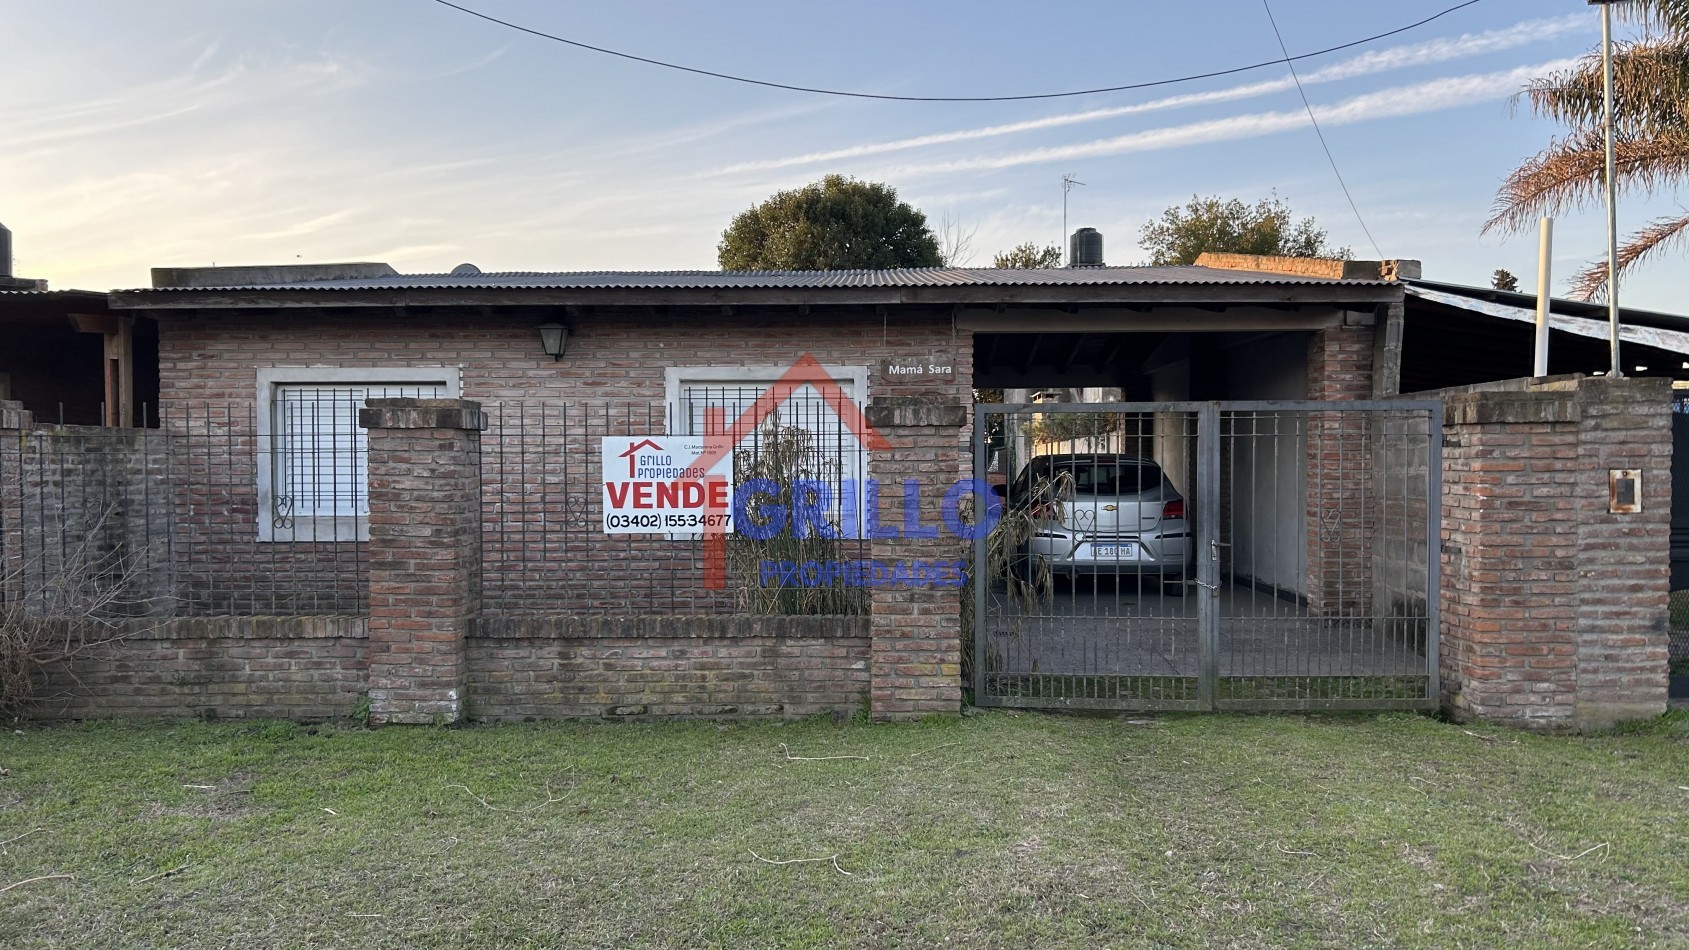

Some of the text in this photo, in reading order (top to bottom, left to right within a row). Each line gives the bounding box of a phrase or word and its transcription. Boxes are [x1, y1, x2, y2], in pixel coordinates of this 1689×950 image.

[889, 364, 952, 375] Mamá Sara
[640, 455, 672, 466] GRILLO
[605, 482, 729, 509] VENDE
[606, 513, 661, 530] (03402)
